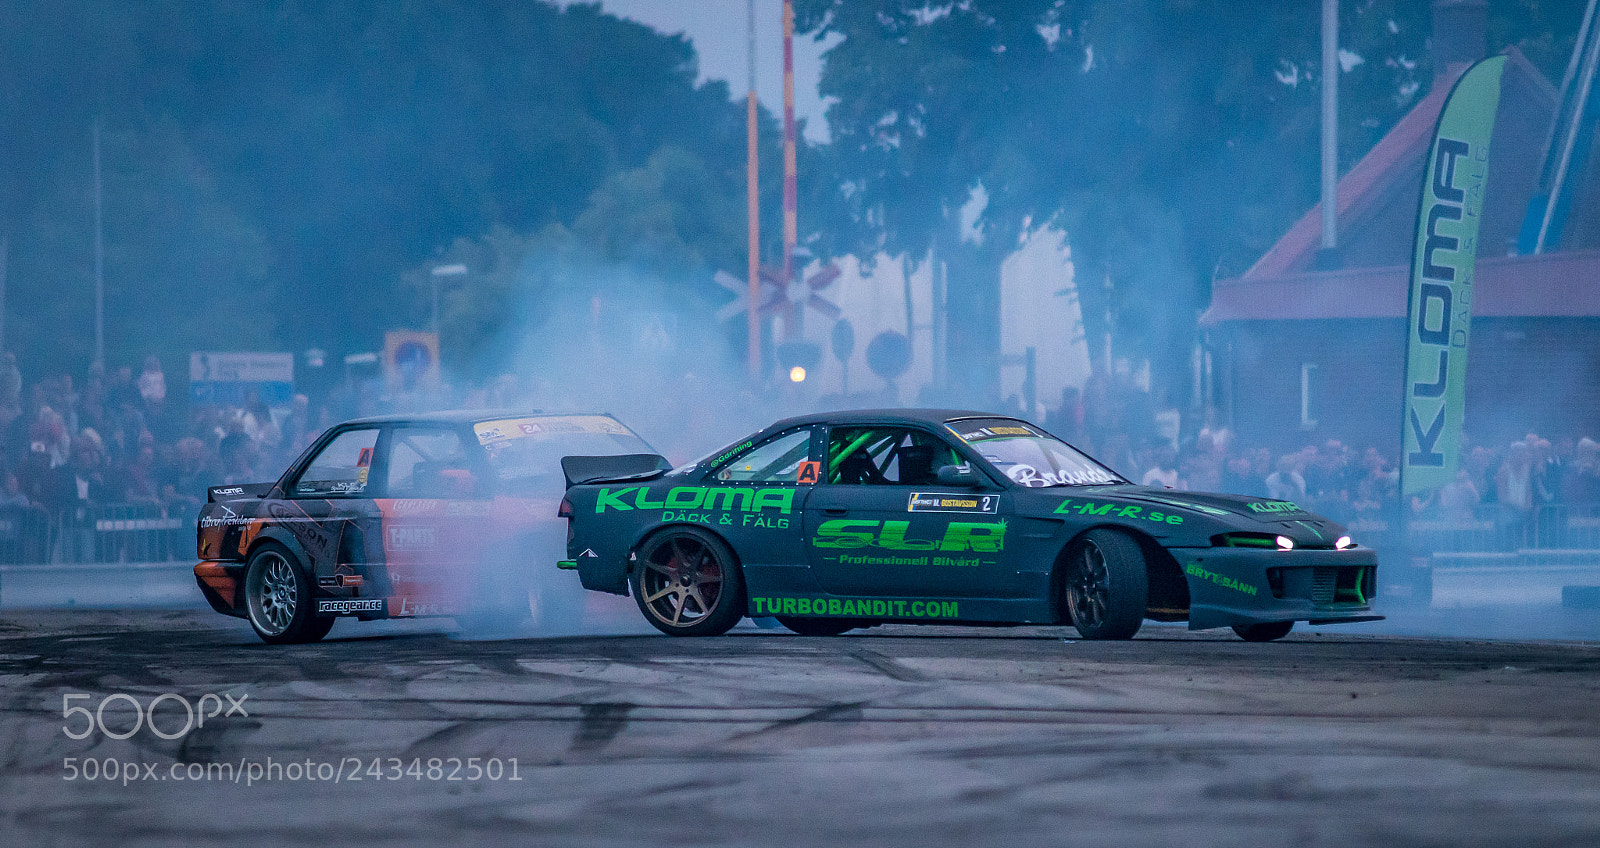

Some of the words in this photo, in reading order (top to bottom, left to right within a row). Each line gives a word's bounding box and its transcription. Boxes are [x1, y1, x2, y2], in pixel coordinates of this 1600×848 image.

[1408, 138, 1470, 468] KLOMA
[358, 449, 370, 466] A
[799, 463, 816, 481] A
[213, 487, 244, 496] KLOMA
[595, 486, 796, 514] KLOMA
[982, 496, 991, 512] 2
[1053, 499, 1184, 525] L-M-R.se
[1246, 501, 1303, 513] KLOMA
[661, 509, 711, 524] DÄCK
[719, 513, 733, 526] &
[742, 513, 789, 529] FÄLG
[816, 518, 1006, 552] SLR
[839, 554, 928, 566] Professionell
[932, 556, 980, 567] Bilvård
[318, 600, 382, 614] racegear.cc
[752, 597, 959, 618] TURBOBANDIT.COM
